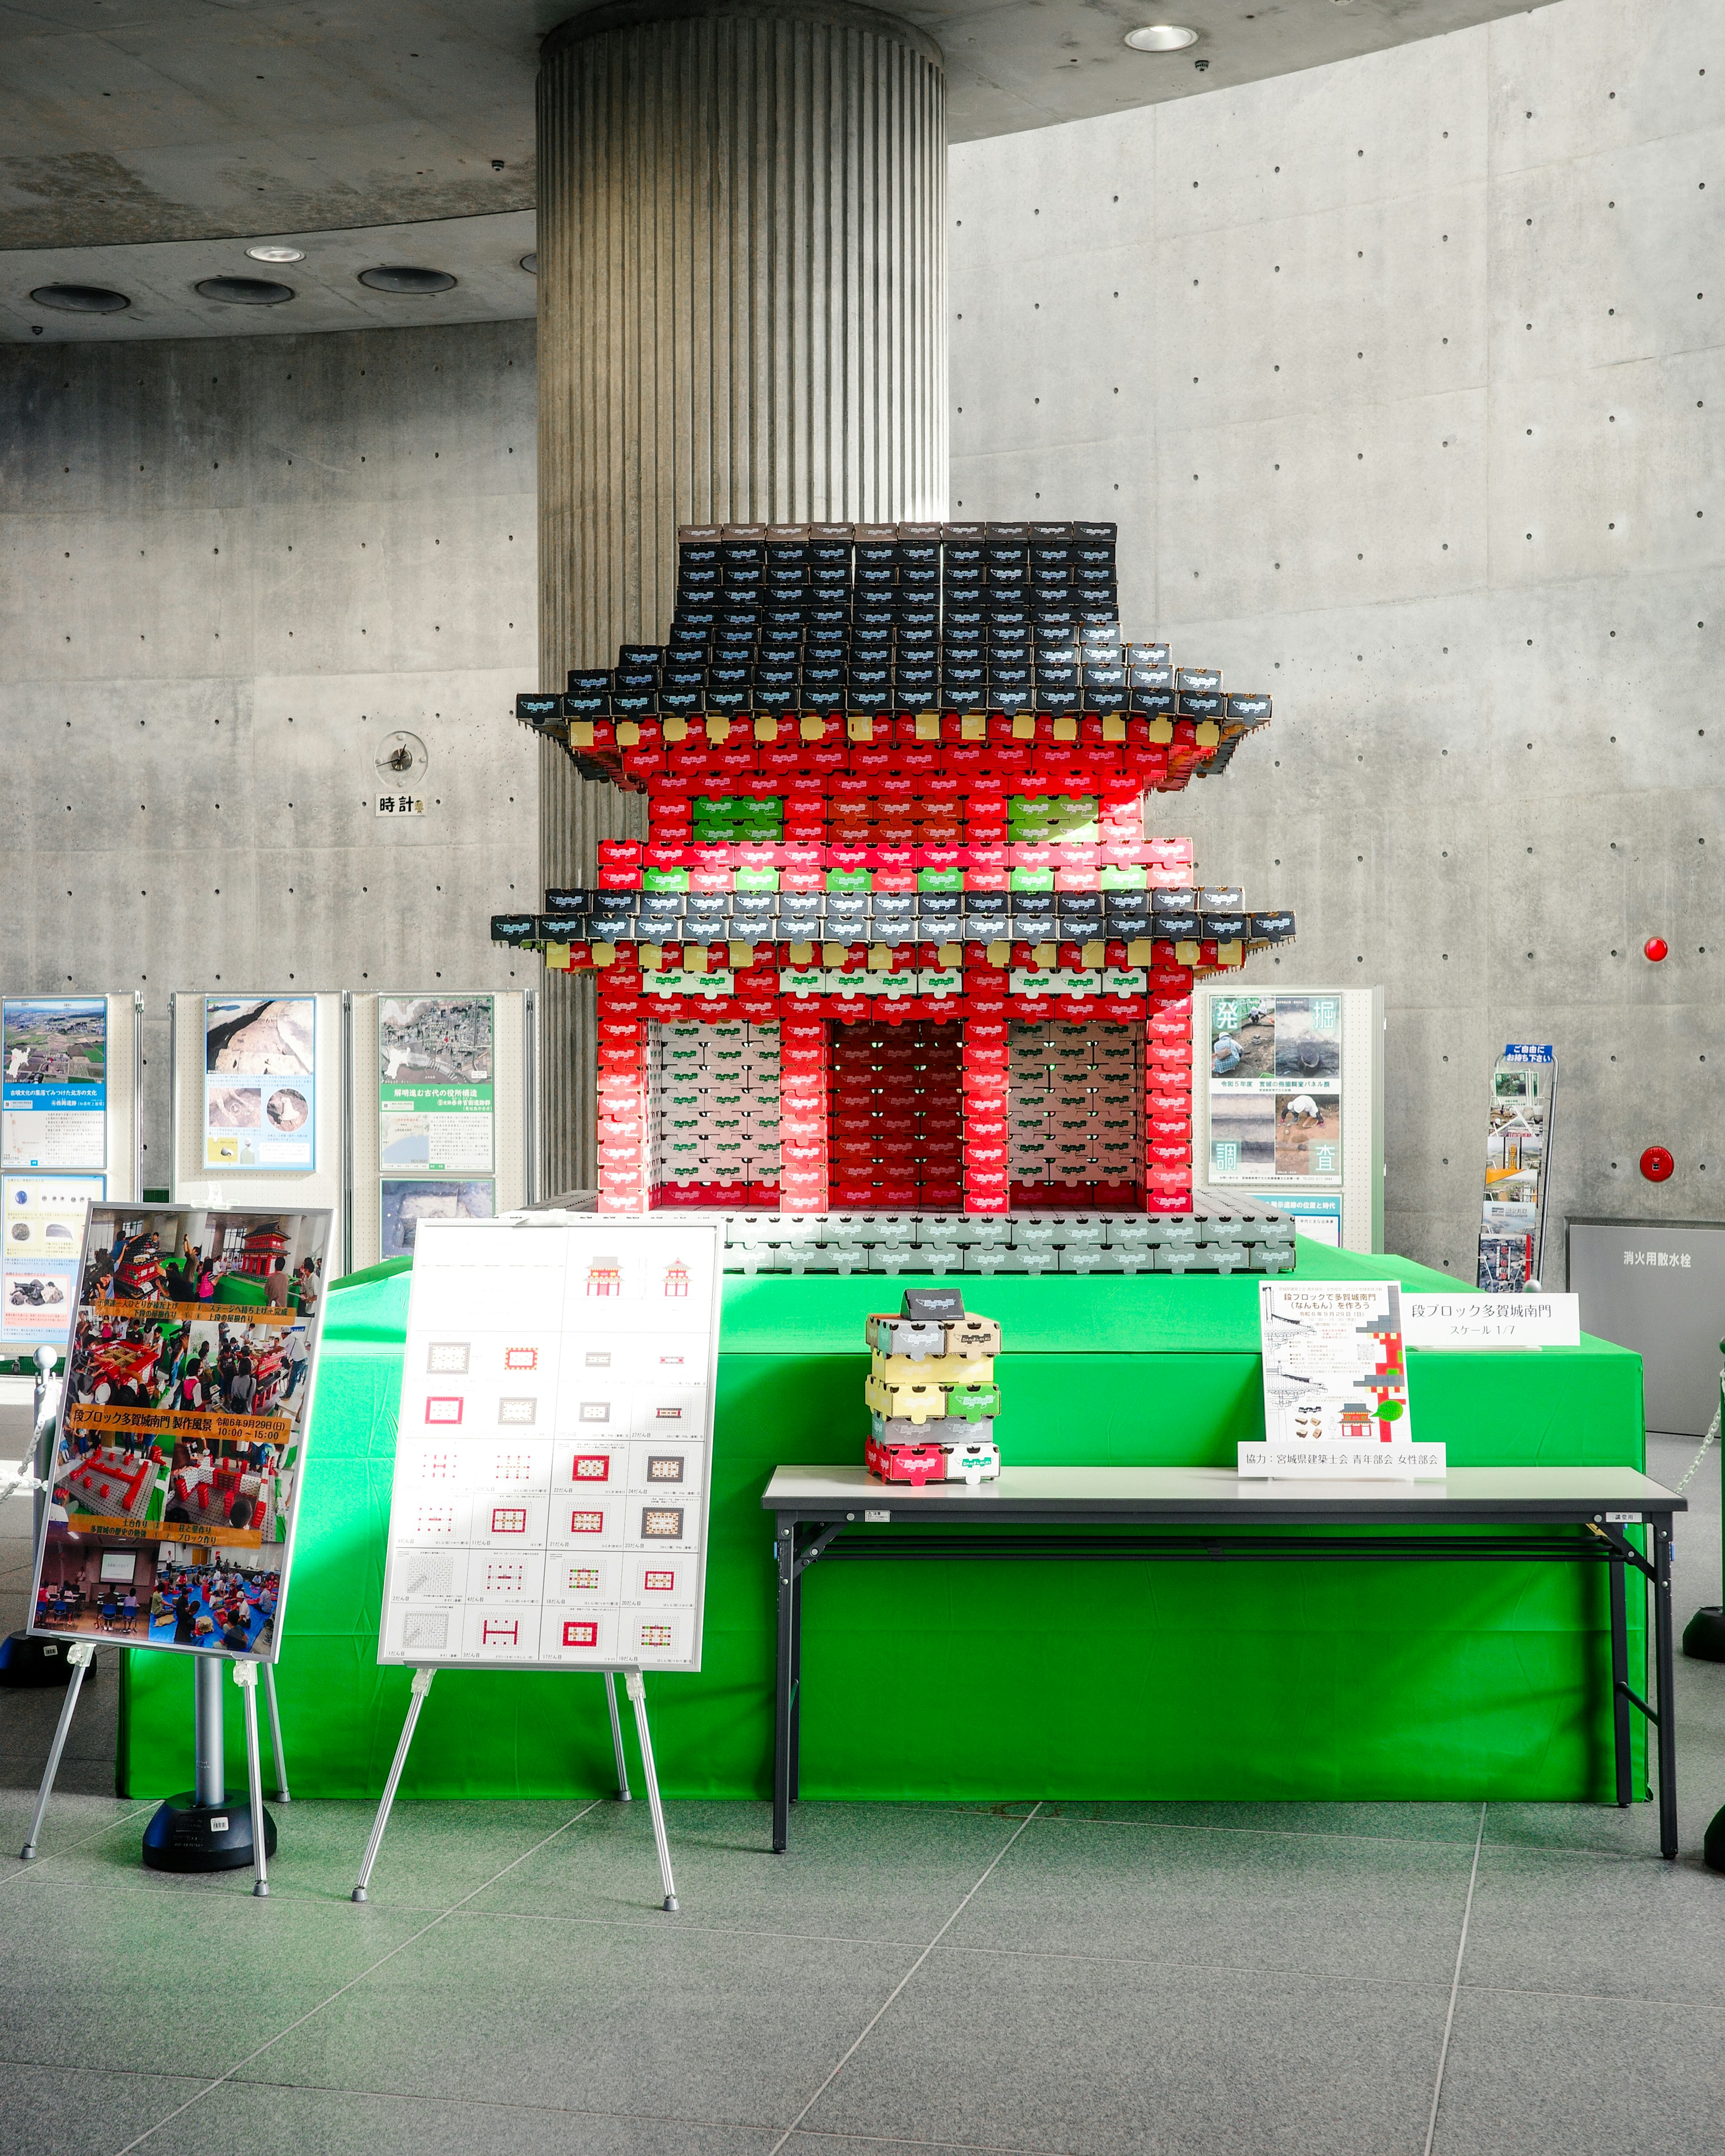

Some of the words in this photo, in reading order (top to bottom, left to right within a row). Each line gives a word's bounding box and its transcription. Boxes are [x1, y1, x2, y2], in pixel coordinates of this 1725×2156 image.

[380, 796, 413, 812] 時計
[1217, 1001, 1238, 1029] 発
[1314, 1001, 1335, 1029] 掘
[1506, 1054, 1552, 1063] お持ち下さい
[394, 1089, 478, 1097] 解明進む古代の役所構造
[1216, 1143, 1237, 1171] 調
[1315, 1144, 1335, 1171] 査
[1623, 1251, 1691, 1268] 消火用散水栓
[133, 1309, 177, 1319] 下段の屋根作り
[208, 1314, 253, 1323] 上段の屋根作り
[1411, 1303, 1552, 1319] 段ブロック多賀城南門
[1450, 1325, 1491, 1335] スケール
[1496, 1325, 1515, 1336] 1/7
[74, 1409, 171, 1430] 段ブロック多賀城南門
[173, 1416, 212, 1432] 製作風景
[1246, 1454, 1348, 1466] 協力：宮城県建築士会
[1353, 1454, 1393, 1466] 青年部会
[1398, 1454, 1439, 1466] 女性部会
[90, 1524, 146, 1538] 多賀城の歴史の勉強
[177, 1534, 217, 1544] ブロック作り
[123, 1520, 147, 1529] 土台作り
[179, 1524, 211, 1534] 柱と壁作り
